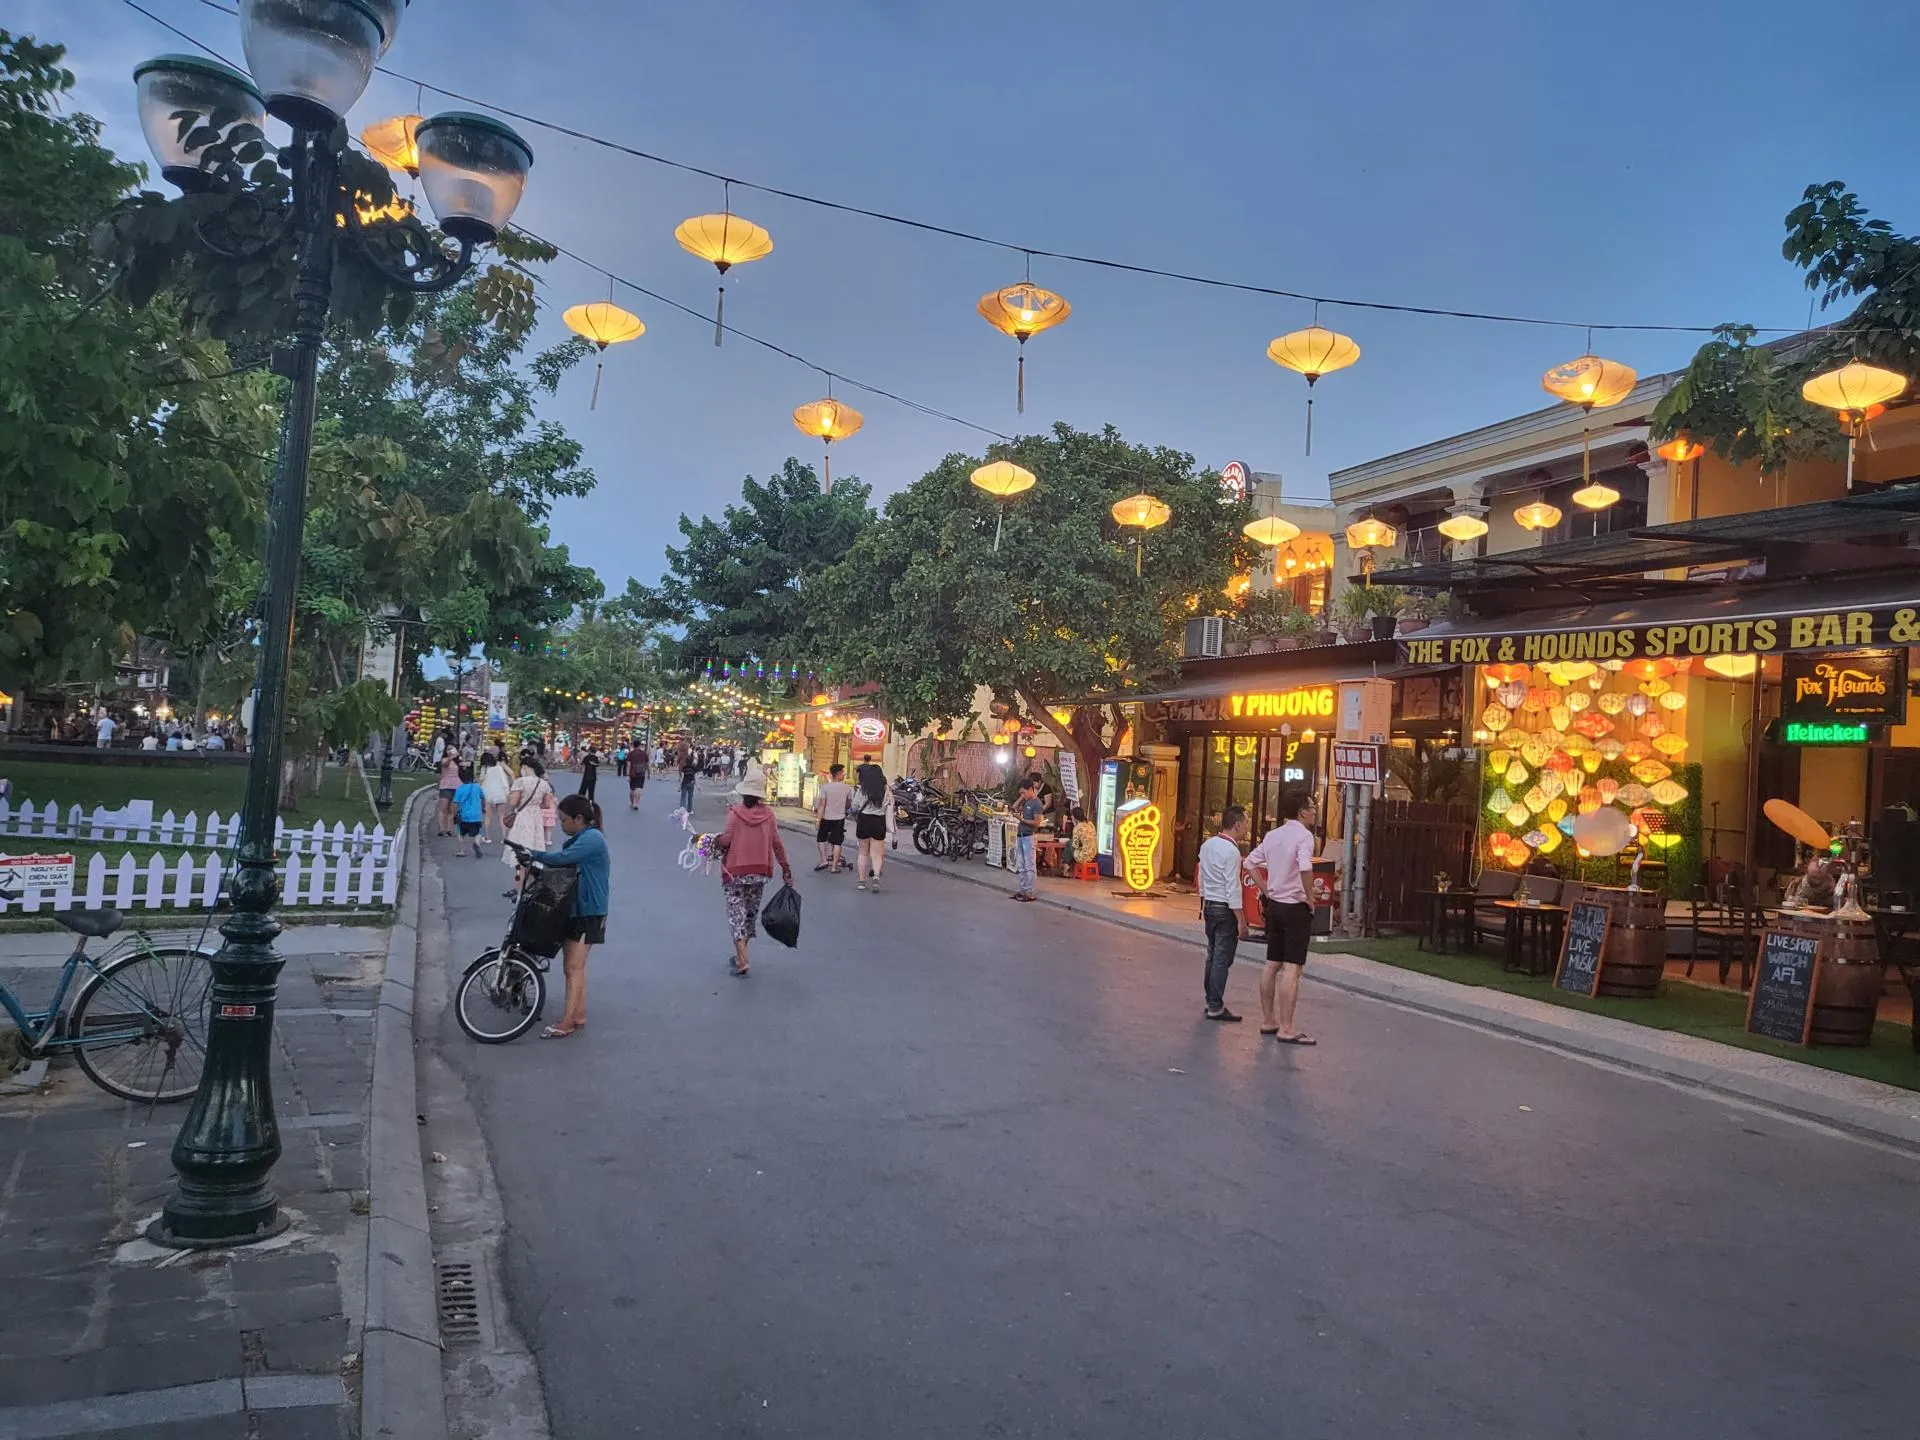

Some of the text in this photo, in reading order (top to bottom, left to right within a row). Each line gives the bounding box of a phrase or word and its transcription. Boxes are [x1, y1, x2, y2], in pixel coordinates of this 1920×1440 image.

[1407, 608, 1920, 664] THE FOX & HOUNDS SPORTS BAR &
[1815, 664, 1838, 678] The
[1795, 669, 1886, 706] Fox Hounds
[1787, 724, 1866, 741] Heineken
[1568, 938, 1592, 955] LIVE
[1767, 934, 1788, 949] LIVE
[1568, 953, 1598, 974] MUSIC
[1768, 951, 1808, 968] WATCH
[1771, 966, 1802, 985] AFL
